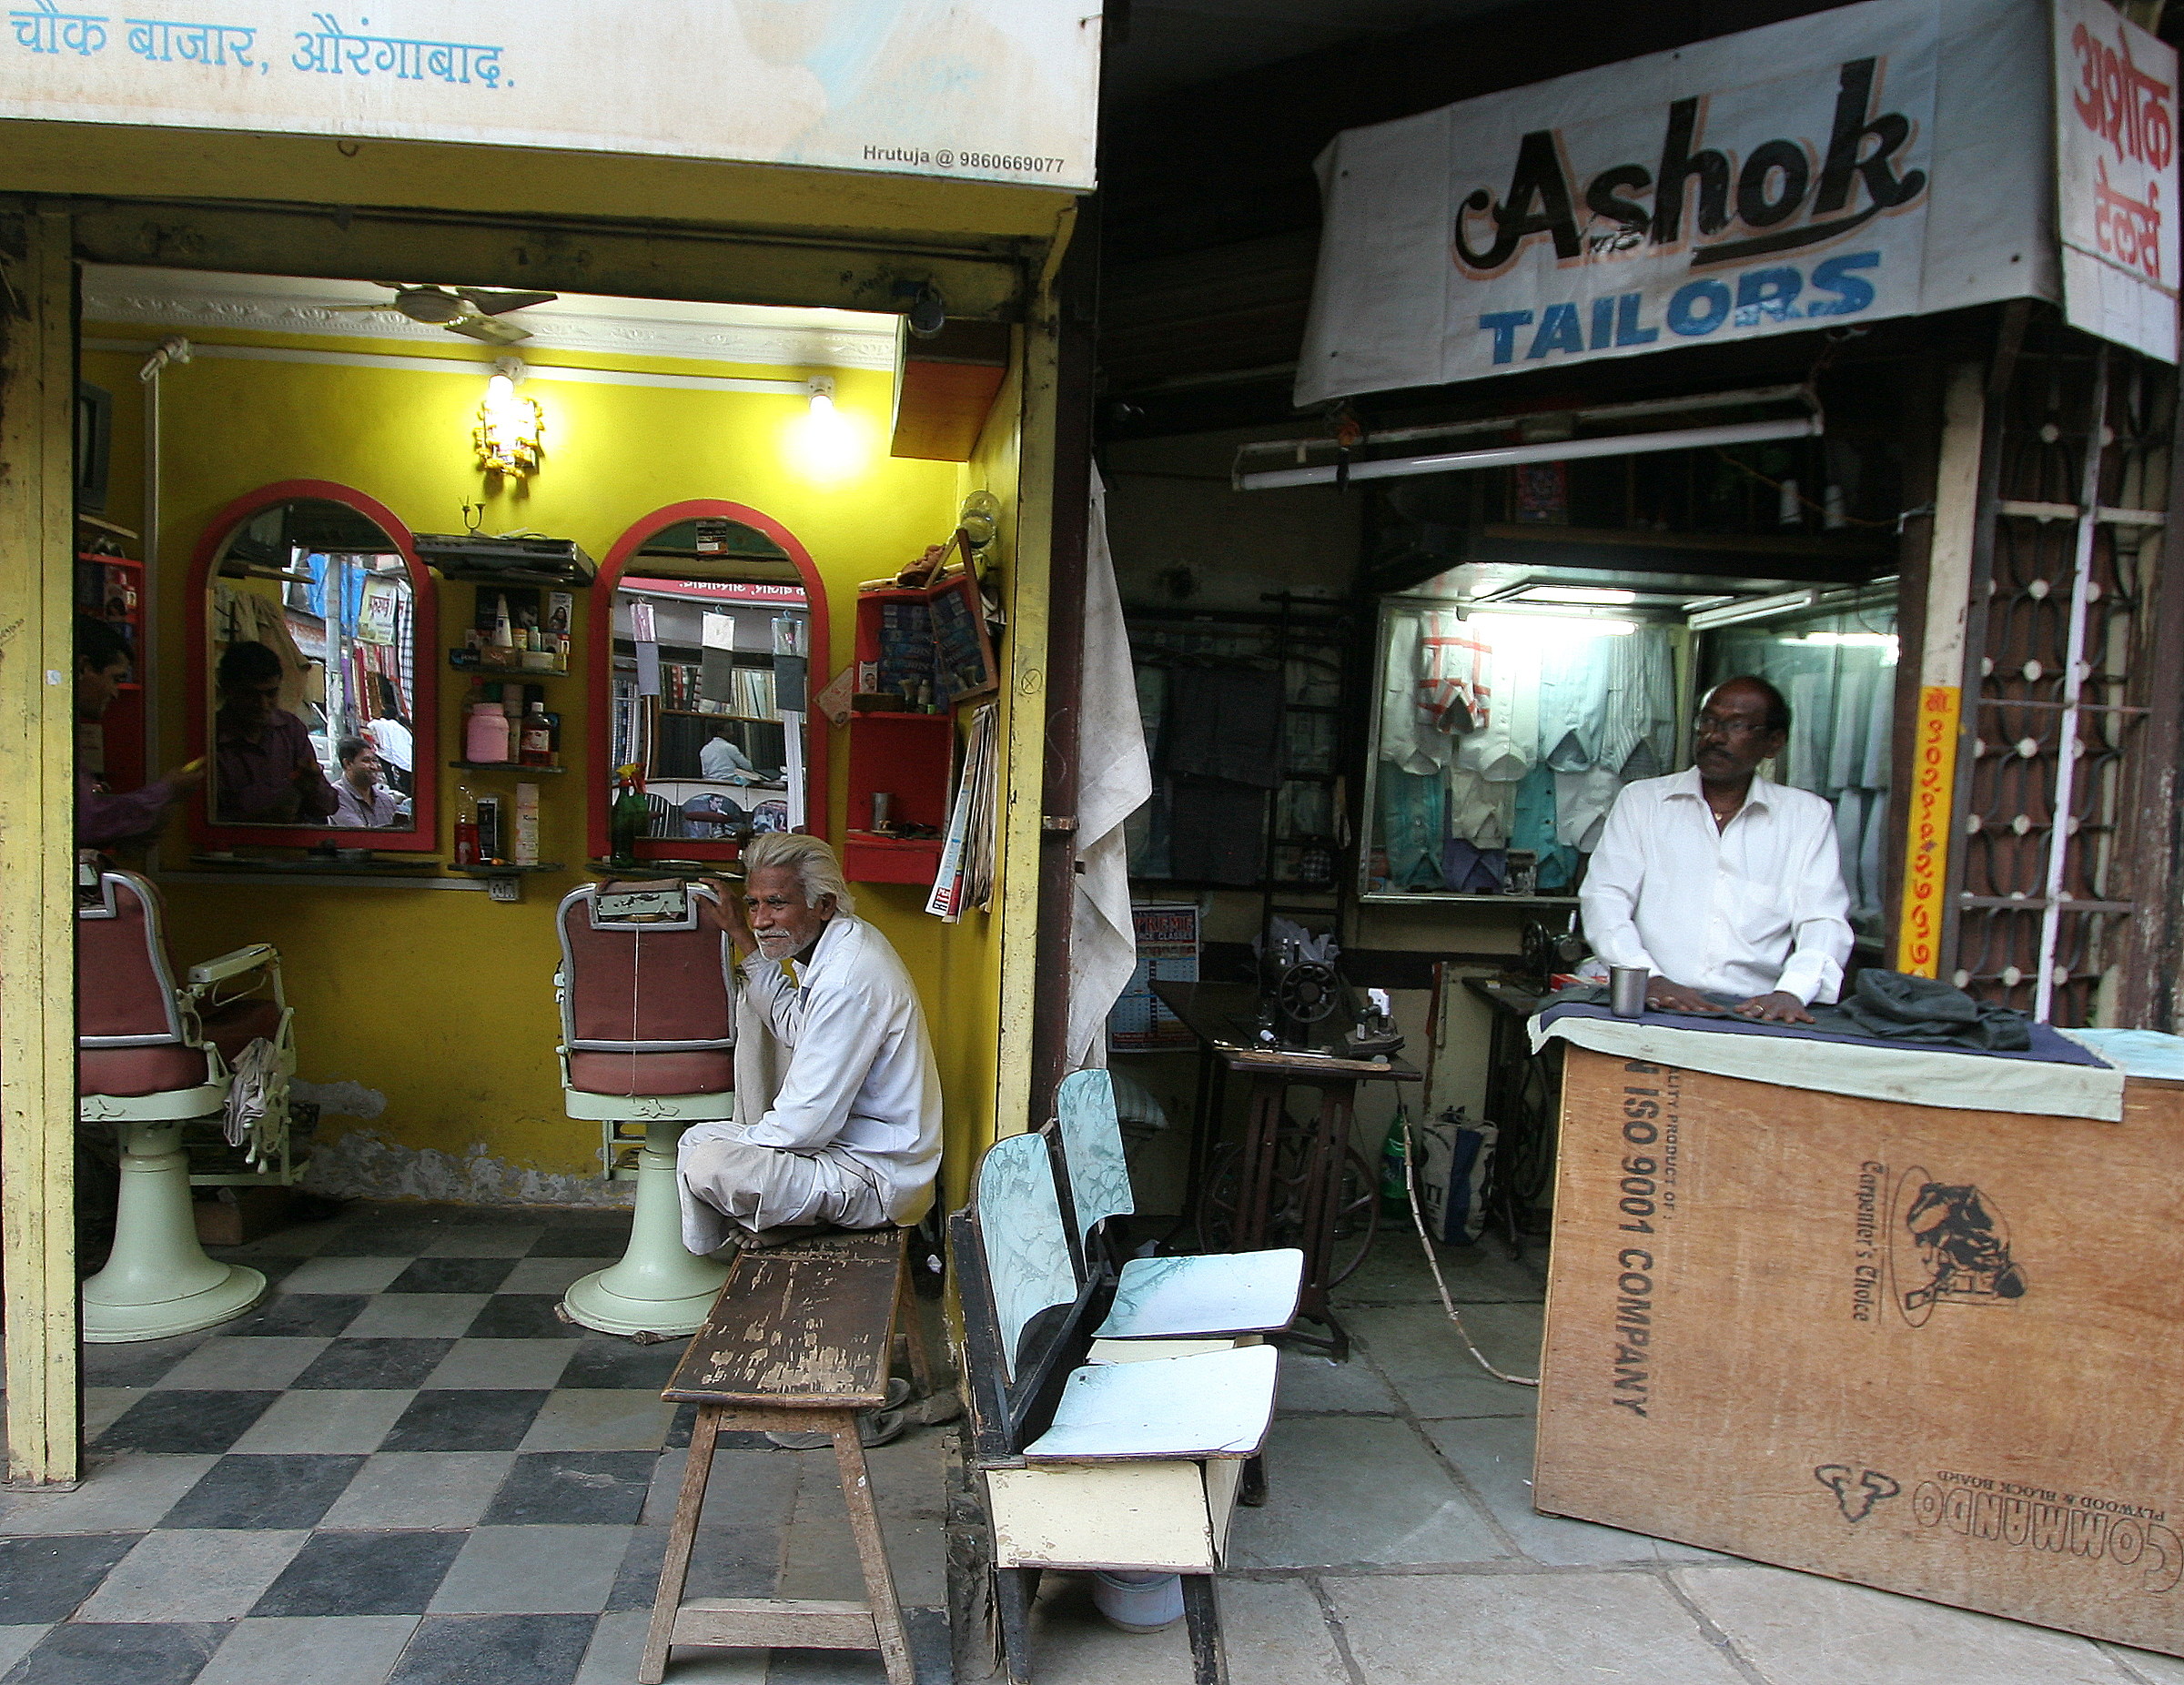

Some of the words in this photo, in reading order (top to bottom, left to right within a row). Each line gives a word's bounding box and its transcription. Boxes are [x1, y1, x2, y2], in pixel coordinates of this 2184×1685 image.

[9, 0, 108, 55] चौक
[125, 18, 269, 75] बाजार,
[291, 13, 515, 89] औरंगाबाद.
[2071, 22, 2171, 173] अशोक
[864, 146, 930, 166] Hrutuja
[935, 149, 955, 167] @
[960, 151, 1065, 173] 9860669077
[1456, 55, 1926, 270] Ashok
[1479, 250, 1881, 365] TAILORS
[1623, 1086, 1660, 1145] ISO
[1667, 1067, 1681, 1107] ALITY
[1664, 1114, 1679, 1185] PRODUCT
[1619, 1155, 1657, 1234] 9001
[1854, 1161, 1884, 1258] Carpenter's
[1853, 1265, 1879, 1322] Choice
[1613, 1248, 1653, 1418] COMPANY
[1937, 1470, 1994, 1490] BOARD
[2001, 1482, 2057, 1501] BLOCK
[2081, 1497, 2166, 1522] PLYWOOD
[1913, 1481, 2184, 1592] COMMANDO
